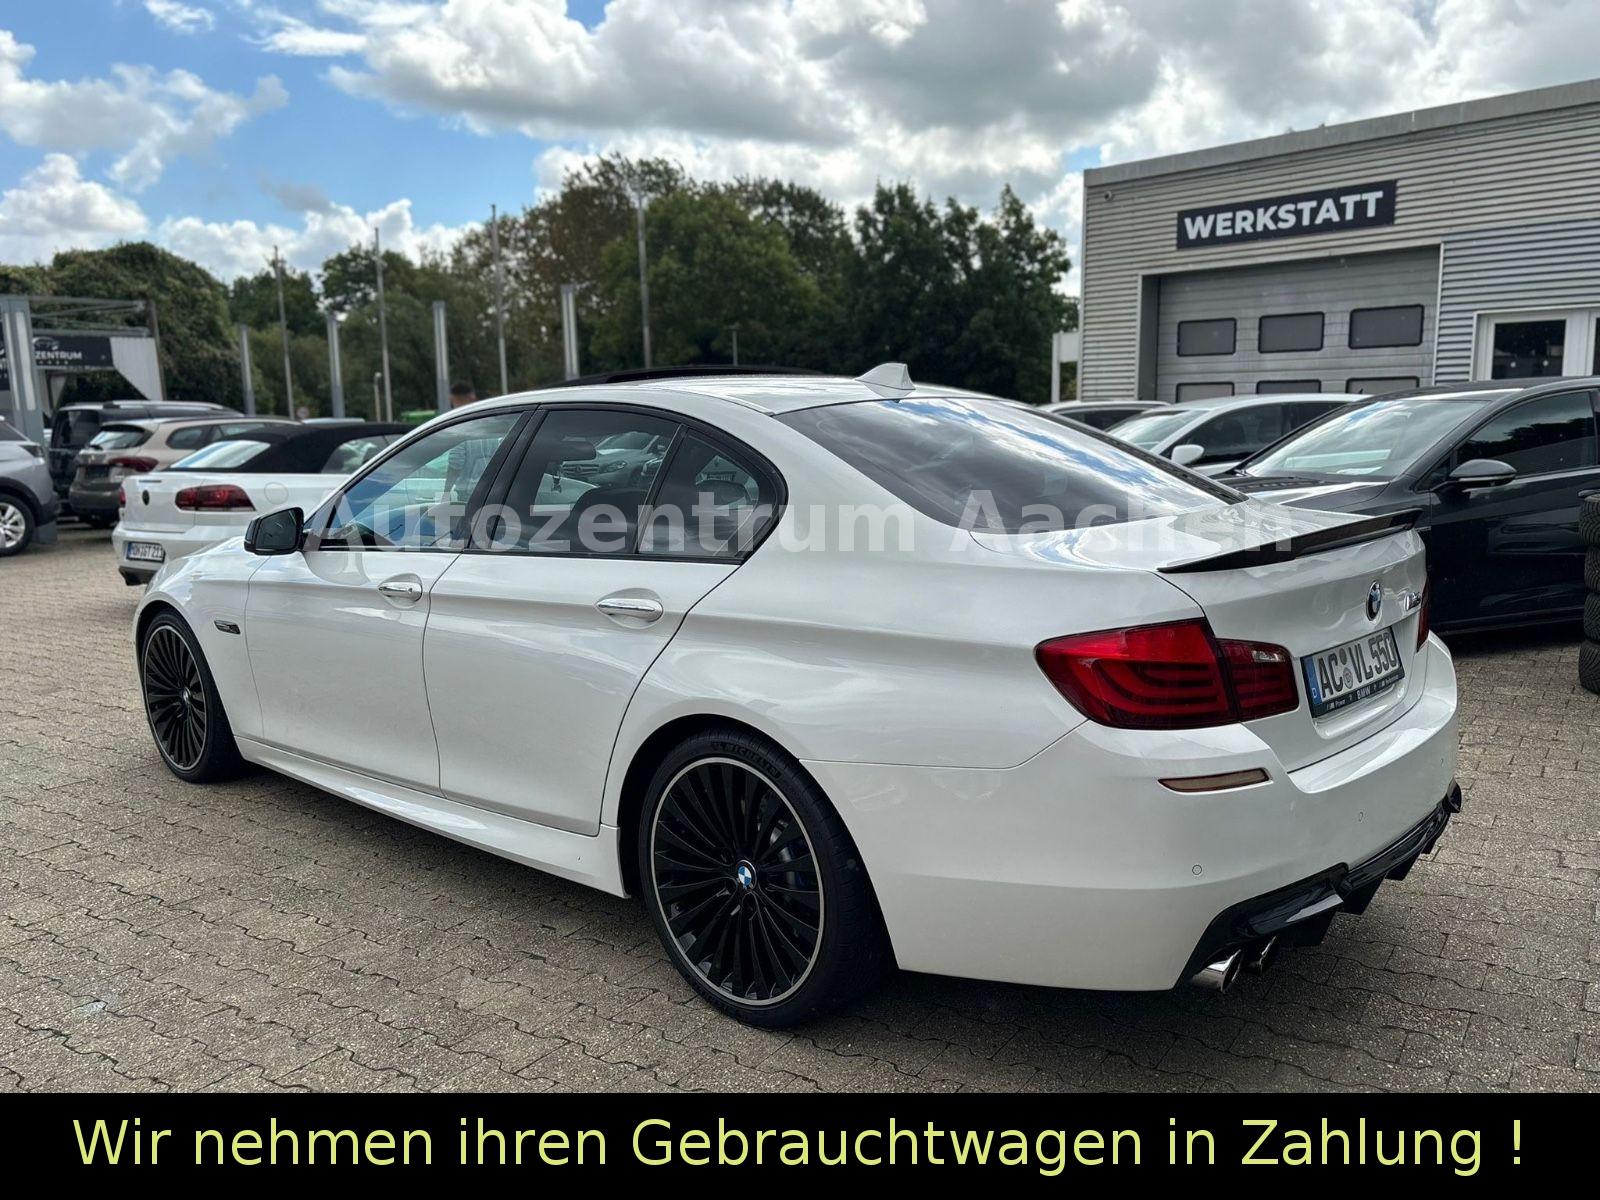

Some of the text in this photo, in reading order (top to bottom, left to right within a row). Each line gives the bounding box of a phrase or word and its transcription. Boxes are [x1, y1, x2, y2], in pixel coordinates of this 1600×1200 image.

[1184, 190, 1384, 240] WERKSTATT
[1317, 631, 1398, 699] AC VL 550
[1356, 685, 1371, 700] BMW
